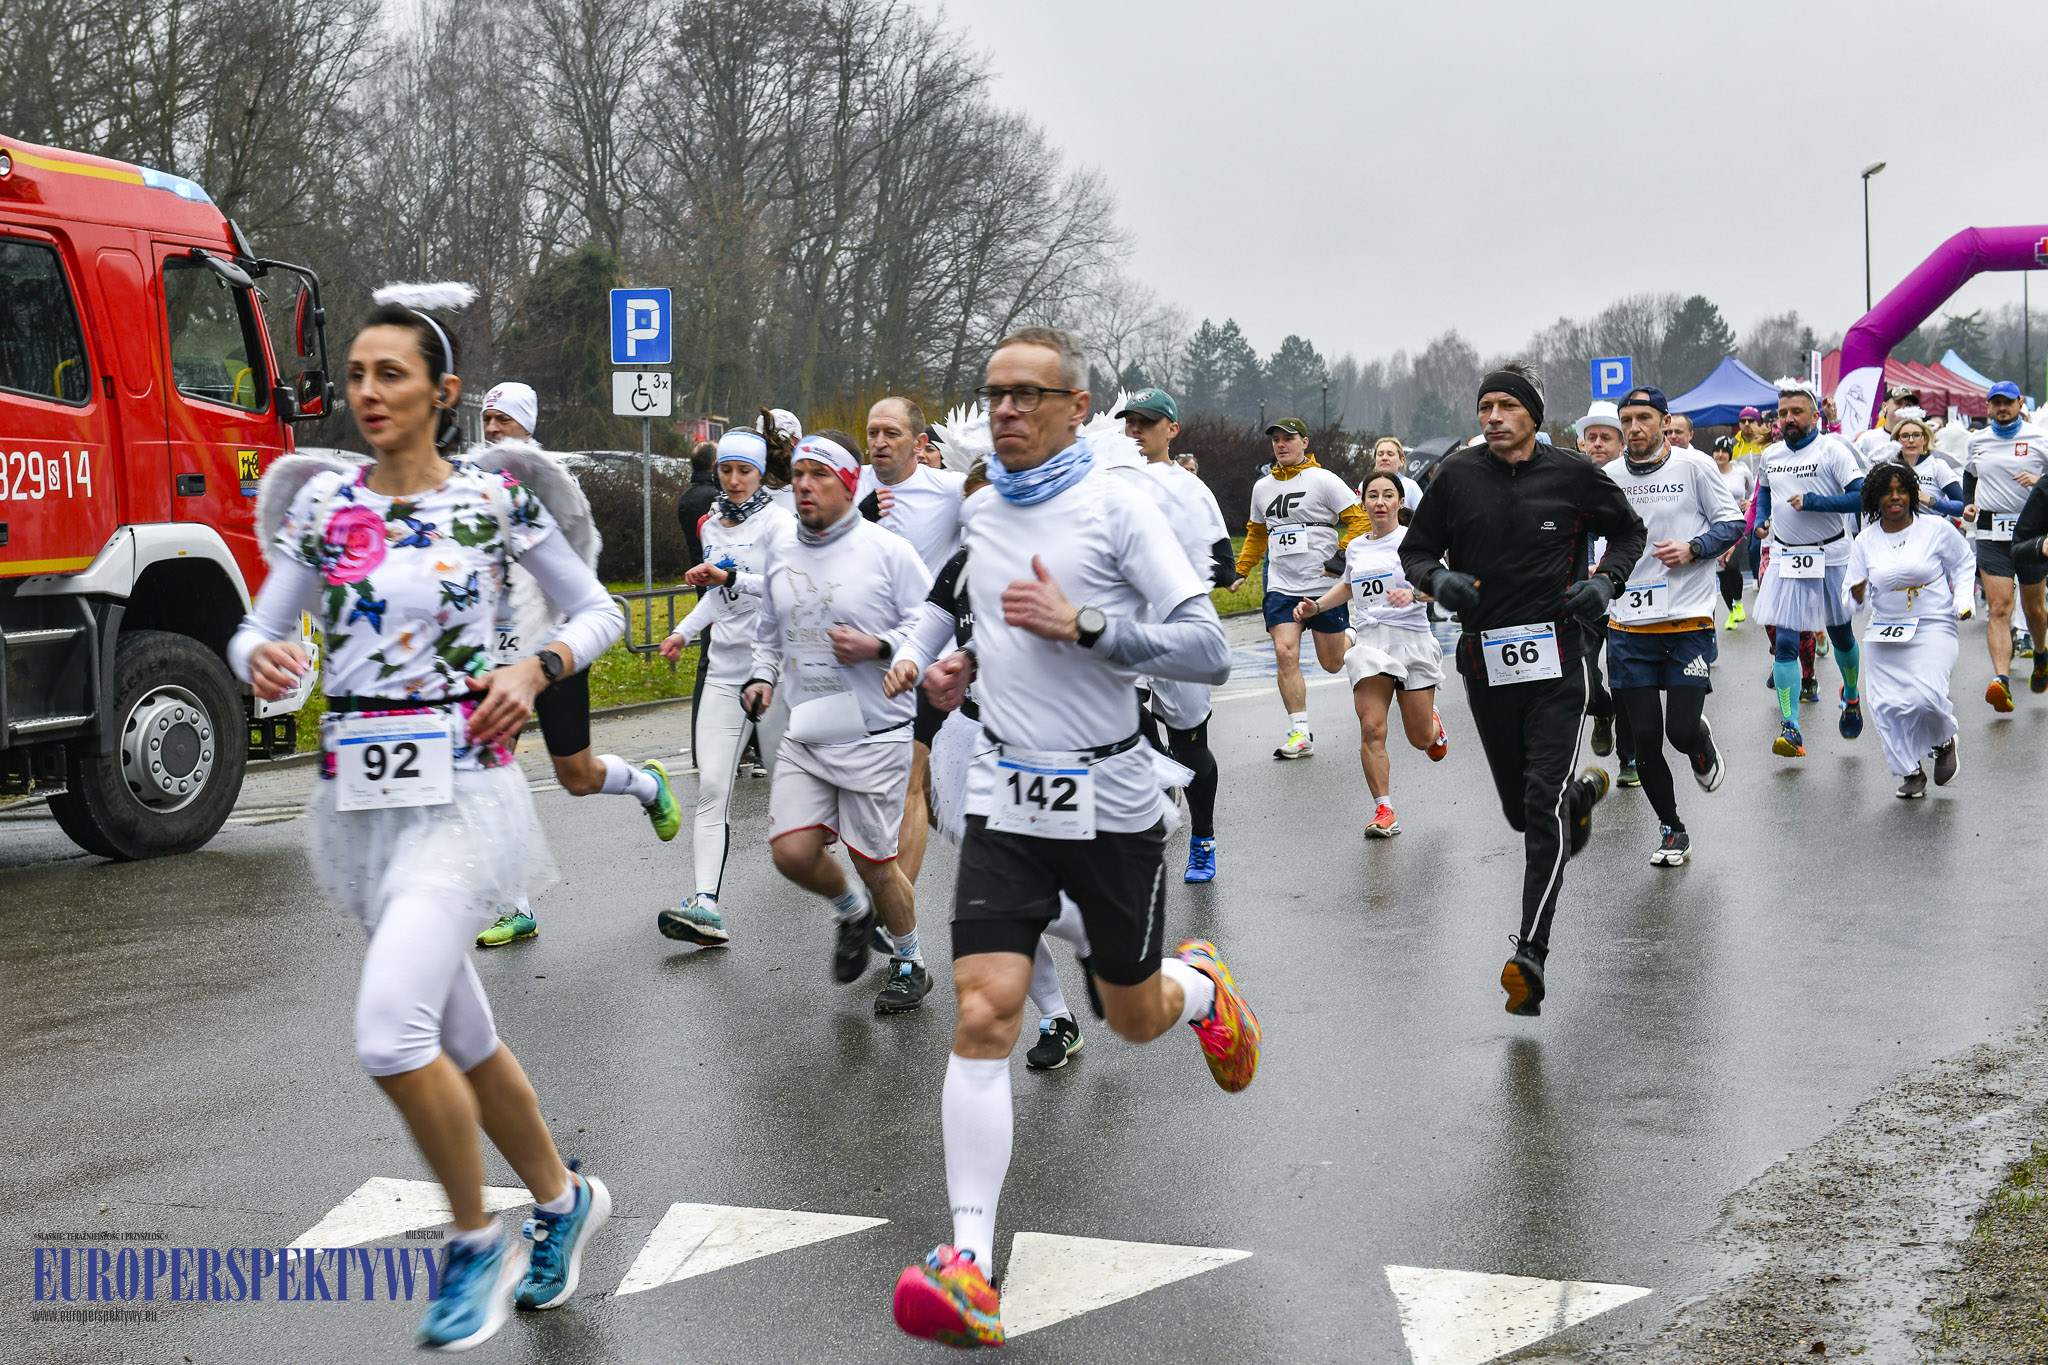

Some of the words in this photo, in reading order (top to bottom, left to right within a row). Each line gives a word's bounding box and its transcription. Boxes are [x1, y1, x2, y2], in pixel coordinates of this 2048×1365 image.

[627, 299, 660, 356] P
[1600, 361, 1624, 395] P
[50, 463, 58, 486] S
[62, 451, 92, 498] 14
[1650, 495, 1680, 504] SUPPORT
[1279, 533, 1297, 546] 45
[1791, 555, 1814, 569] 30
[1361, 579, 1384, 597] 20
[1629, 589, 1653, 608] 31
[1880, 626, 1904, 637] 46
[1501, 641, 1539, 666] 66
[364, 742, 420, 781] 92
[1007, 771, 1078, 812] 142
